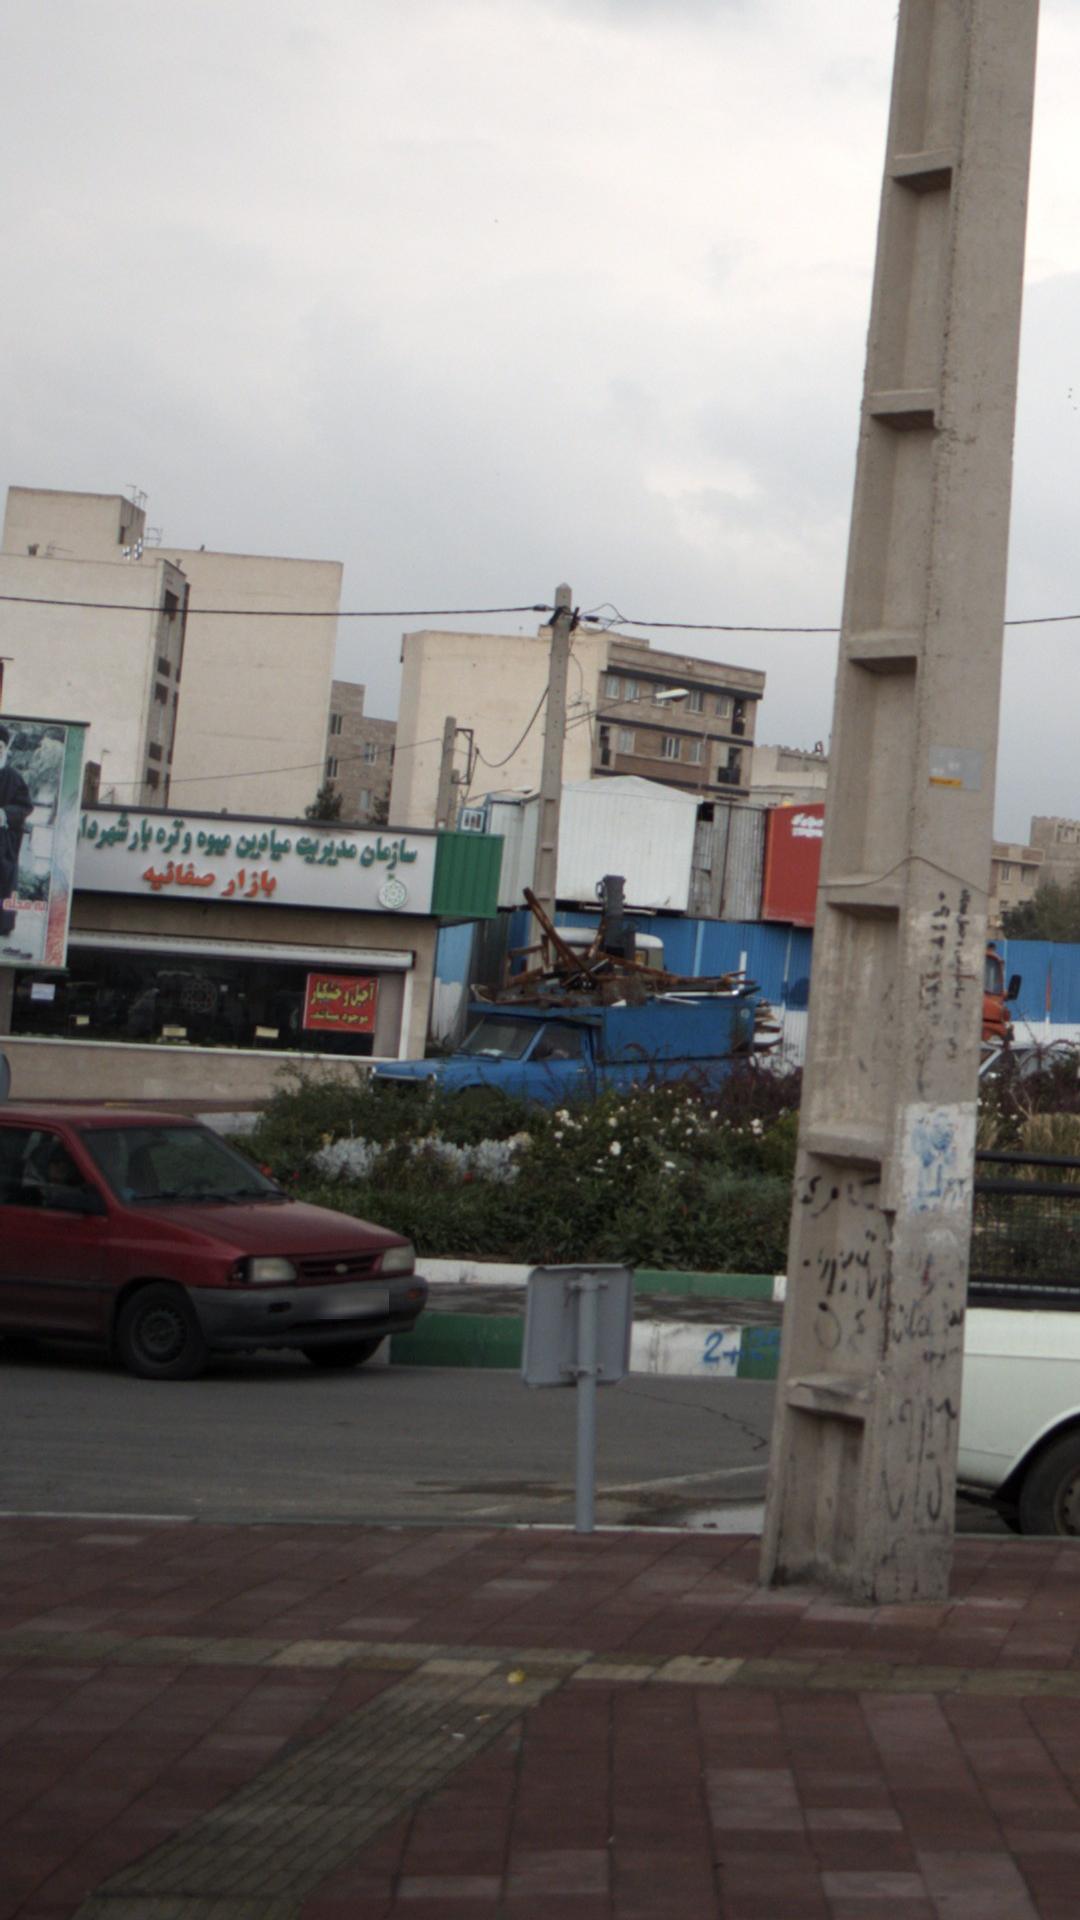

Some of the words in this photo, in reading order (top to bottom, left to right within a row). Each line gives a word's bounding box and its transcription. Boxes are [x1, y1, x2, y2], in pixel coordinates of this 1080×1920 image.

[197, 831, 232, 856] میوه
[236, 828, 292, 861] میادین
[295, 836, 357, 867] مدیریت
[360, 836, 418, 870] سازمان
[220, 868, 277, 897] بازار
